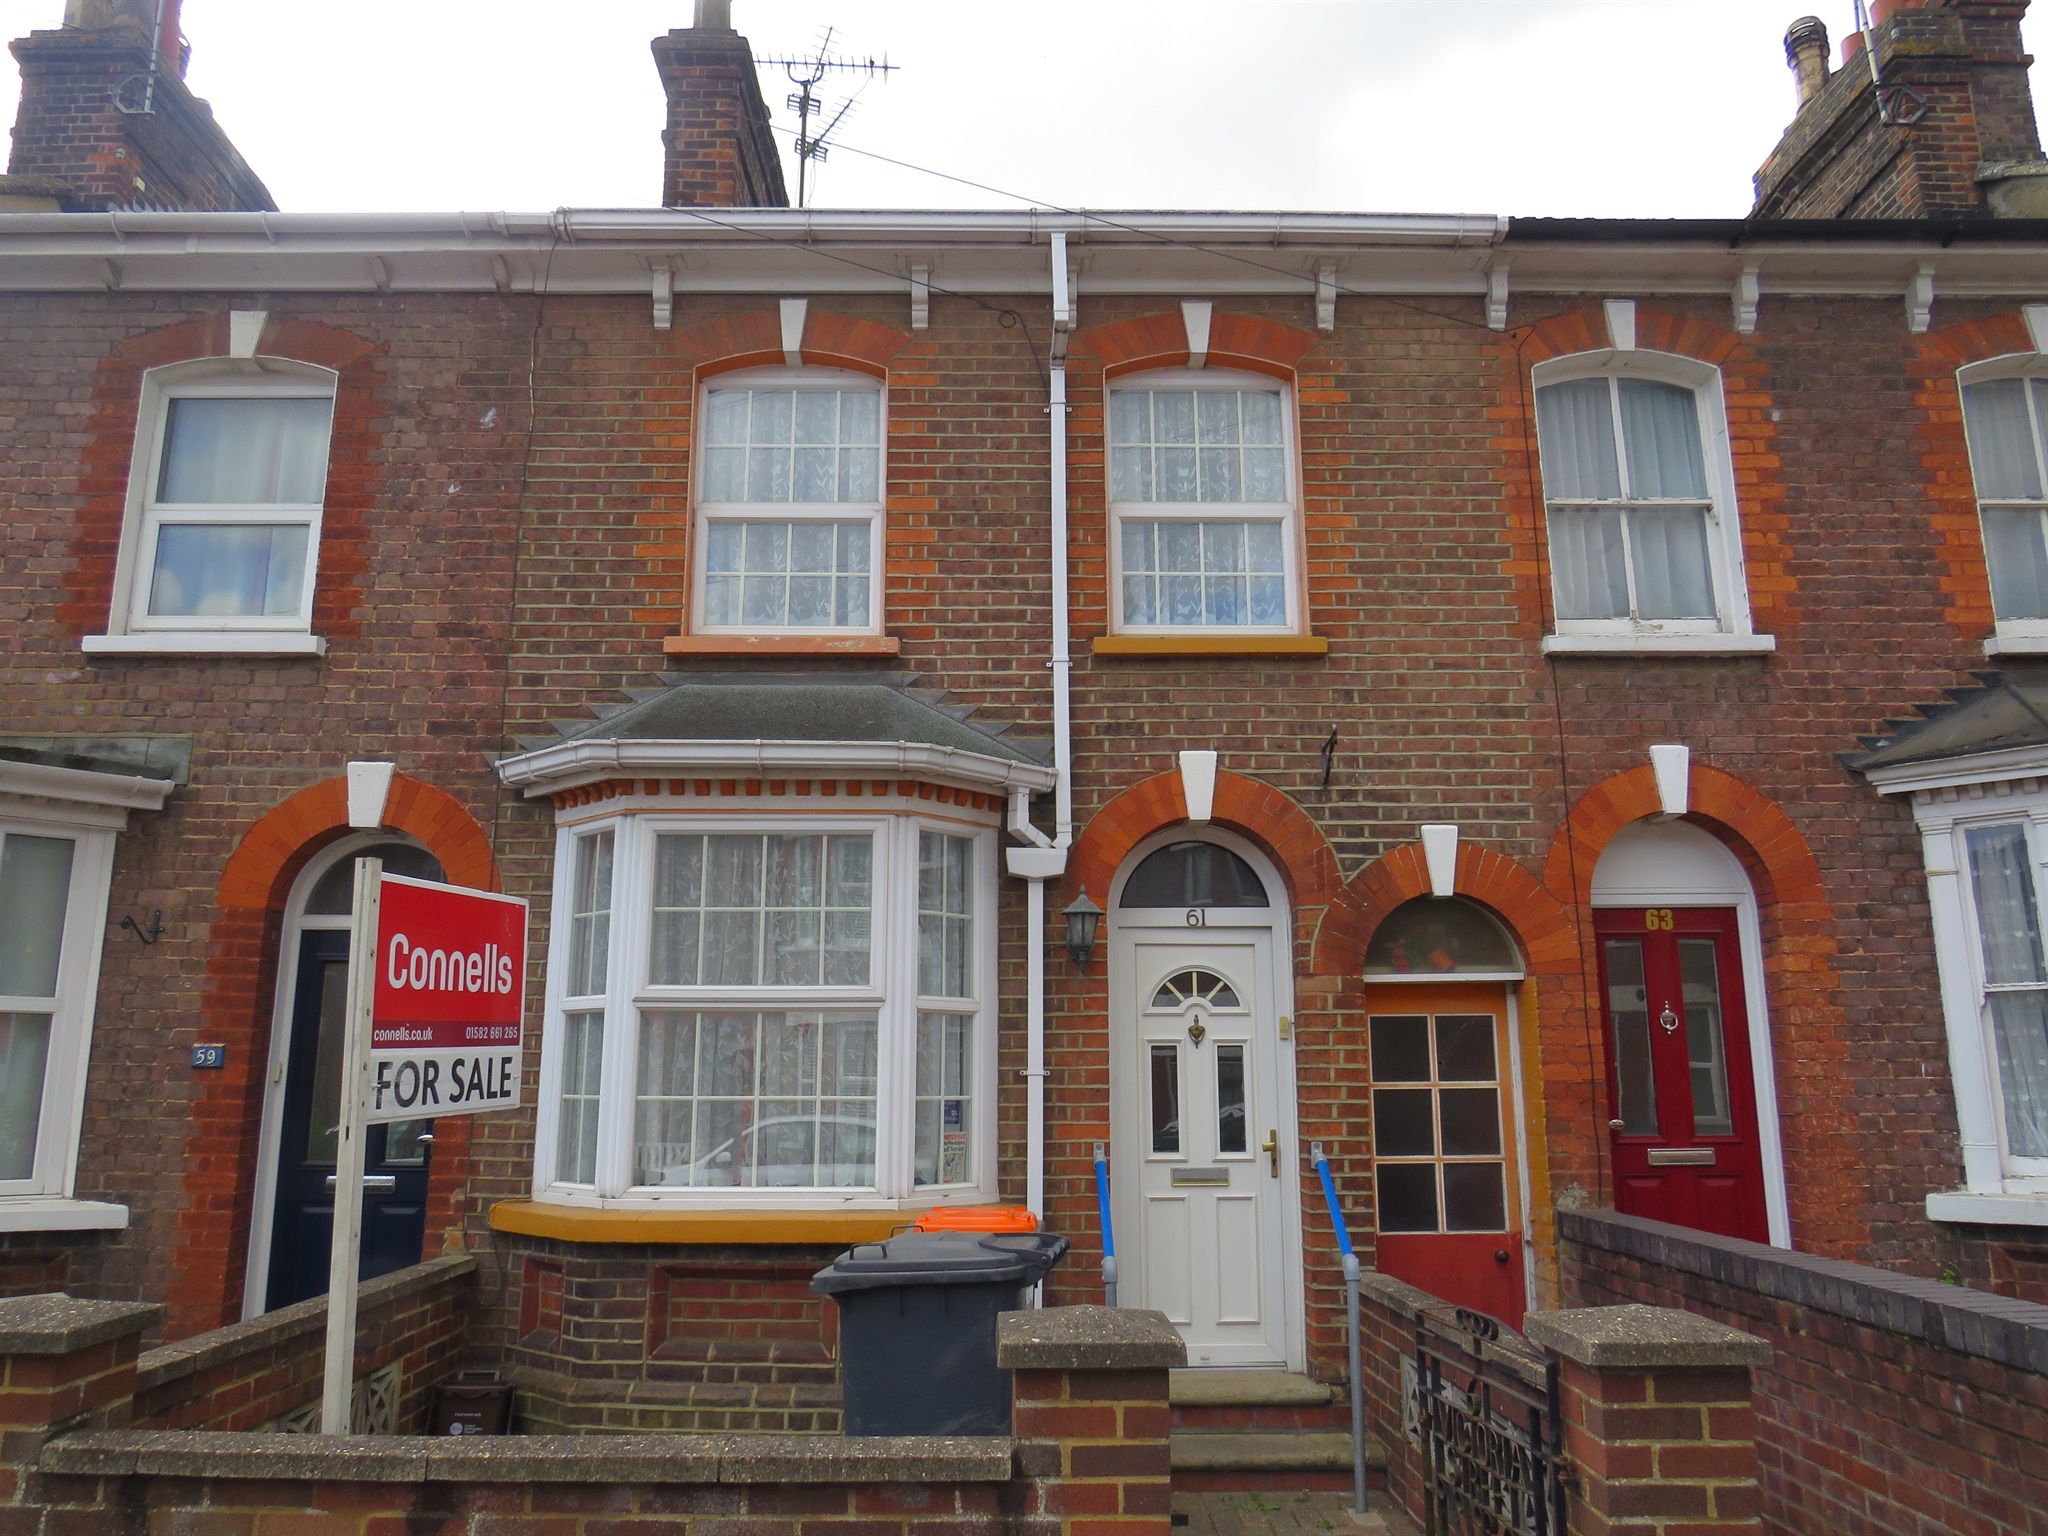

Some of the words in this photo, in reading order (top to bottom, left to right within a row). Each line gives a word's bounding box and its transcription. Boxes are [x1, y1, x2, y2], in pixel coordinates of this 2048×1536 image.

[1187, 909, 1206, 927] 61
[1646, 909, 1673, 930] 63
[388, 933, 512, 994] Connells
[374, 1026, 433, 1041] connells.co.uk
[466, 1026, 488, 1039] 01582
[490, 1026, 502, 1039] 661
[196, 1049, 215, 1064] 59
[376, 1060, 439, 1109] FOR
[449, 1056, 513, 1102] SALE
